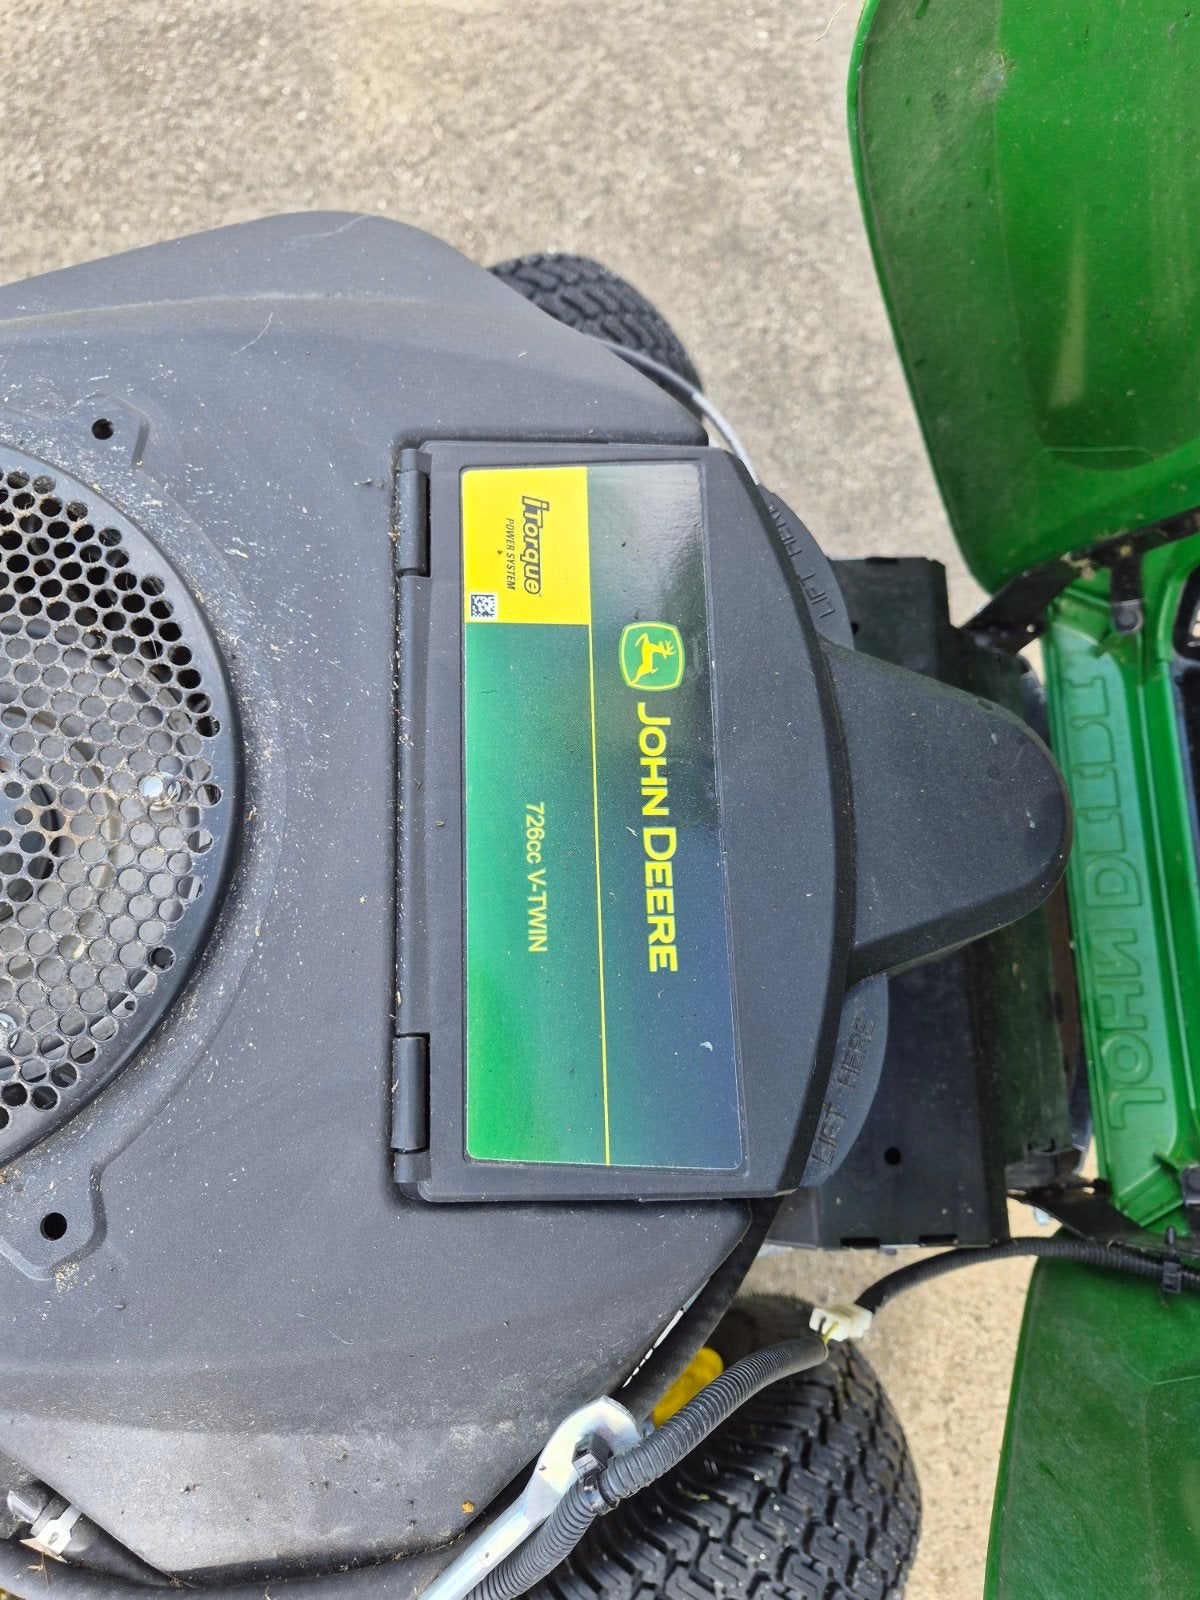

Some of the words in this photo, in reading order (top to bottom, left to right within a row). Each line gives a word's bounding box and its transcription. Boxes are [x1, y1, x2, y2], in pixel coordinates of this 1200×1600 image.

[505, 518, 515, 550] POWER
[506, 553, 516, 590] SYSTEM
[520, 496, 550, 595] iTorque
[797, 572, 836, 618] LIFT
[637, 702, 672, 816] JOHN
[526, 801, 546, 864] 726cc
[527, 868, 548, 952] V-TWIN
[643, 827, 678, 972] DEERE
[810, 1102, 848, 1167] LIFT
[837, 1016, 876, 1089] HERE
